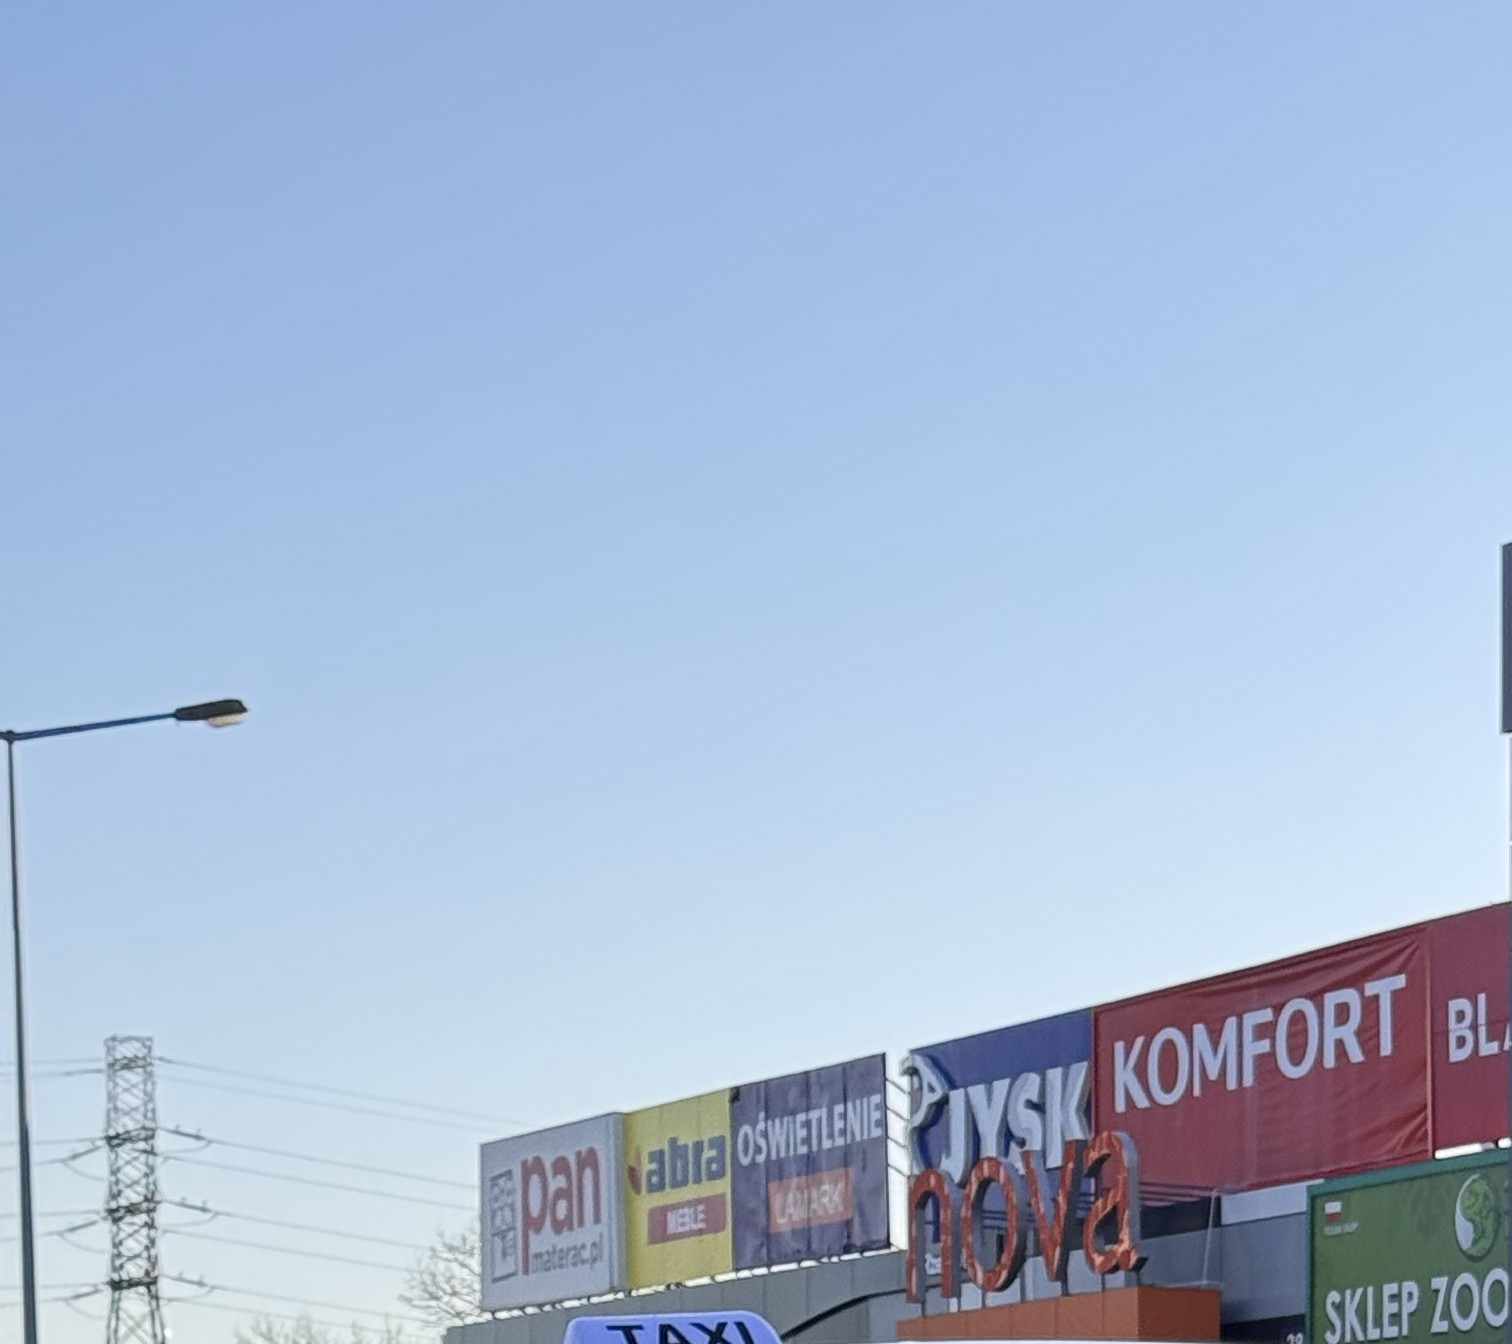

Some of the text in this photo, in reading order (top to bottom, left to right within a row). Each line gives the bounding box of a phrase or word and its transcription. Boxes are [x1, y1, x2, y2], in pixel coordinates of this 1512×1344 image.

[1112, 973, 1407, 1113] KOMFORT
[1447, 993, 1511, 1063] BL
[646, 1134, 727, 1194] abra
[736, 1093, 884, 1167] OŚWIETLENIE
[940, 1060, 1093, 1188] JYSK
[521, 1146, 602, 1276] pan
[905, 1129, 1148, 1302] nova
[1429, 1266, 1510, 1335] ZOO
